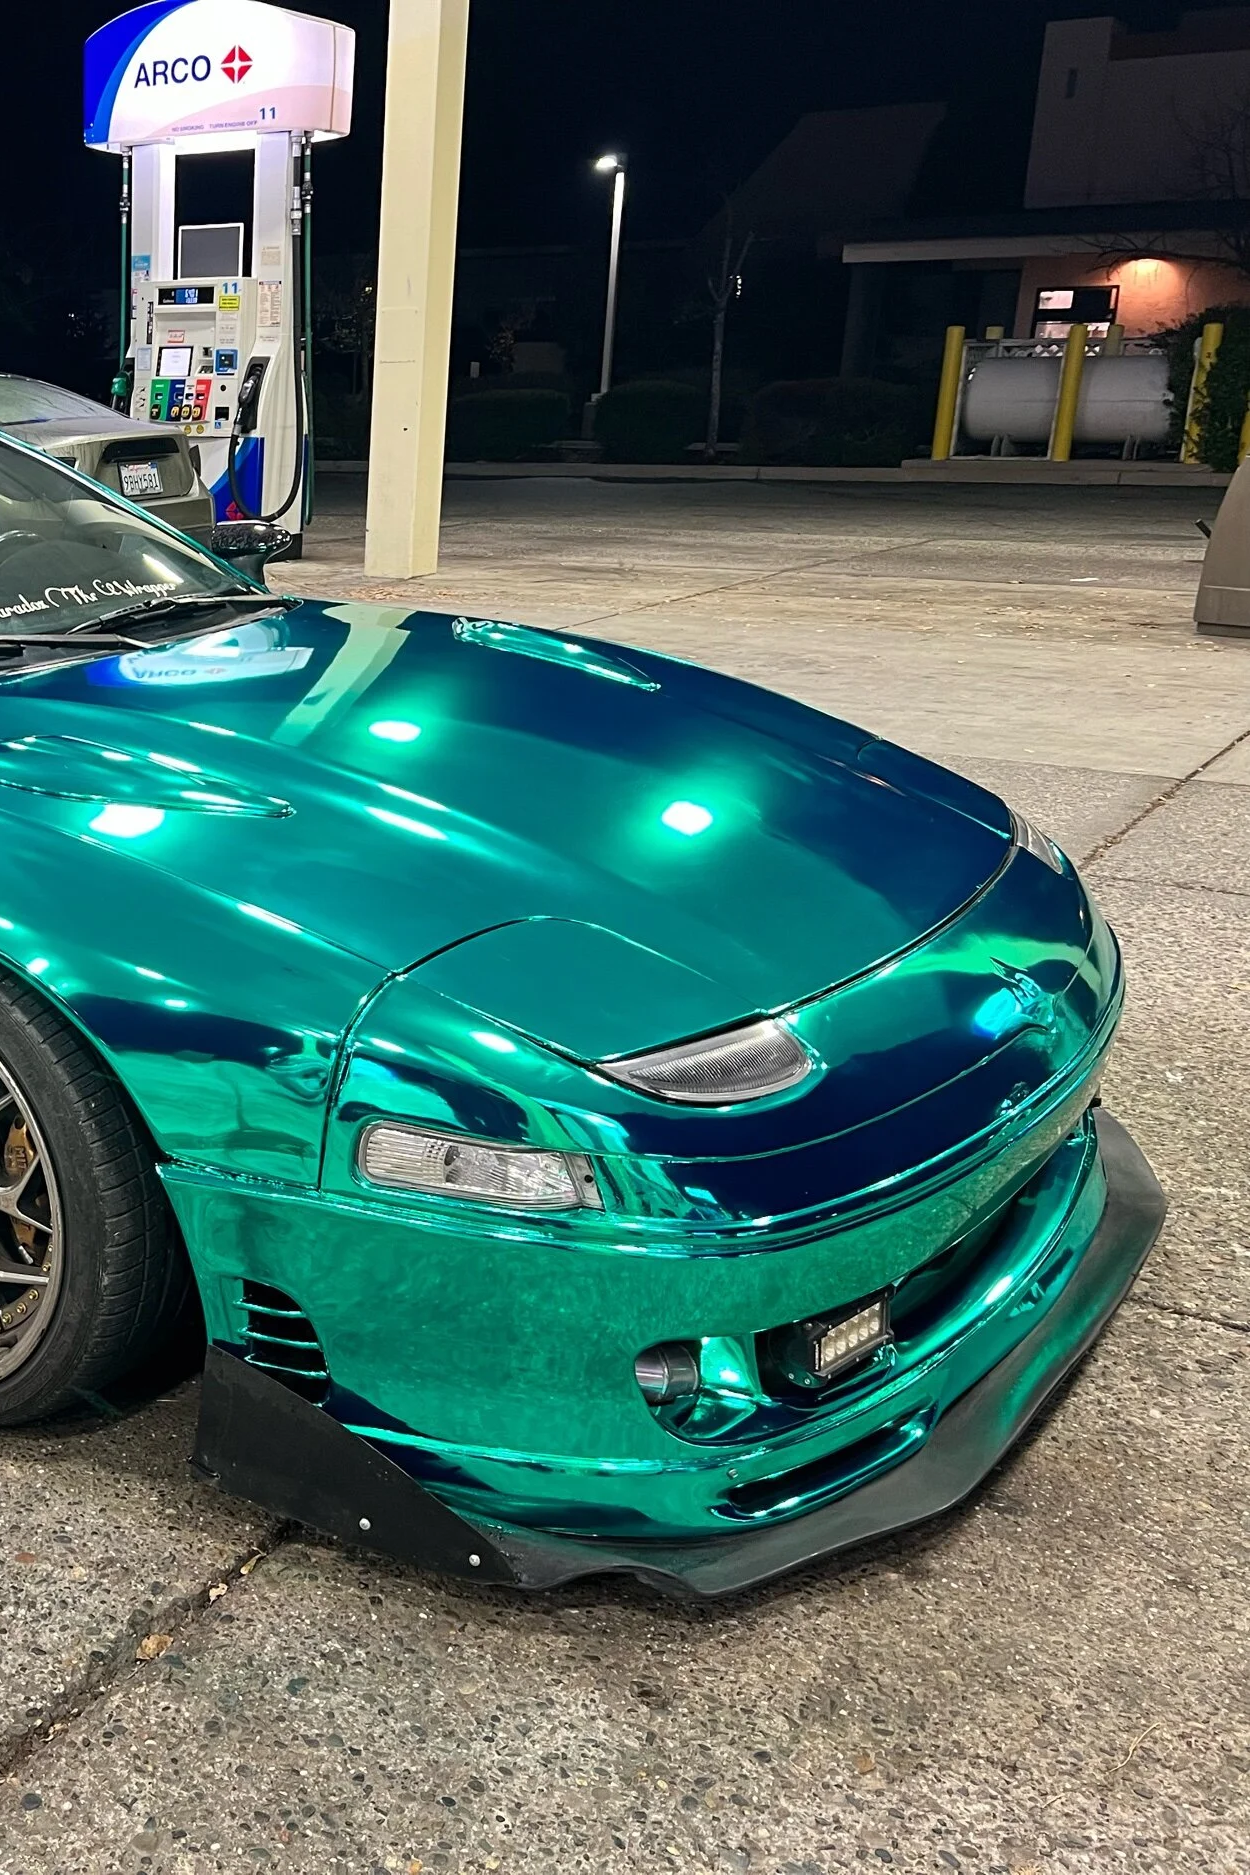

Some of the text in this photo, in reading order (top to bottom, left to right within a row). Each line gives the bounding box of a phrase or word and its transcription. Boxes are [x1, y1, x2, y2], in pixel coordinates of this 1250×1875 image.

[134, 55, 211, 88] ARCO
[259, 107, 277, 120] 11
[222, 282, 238, 294] 11
